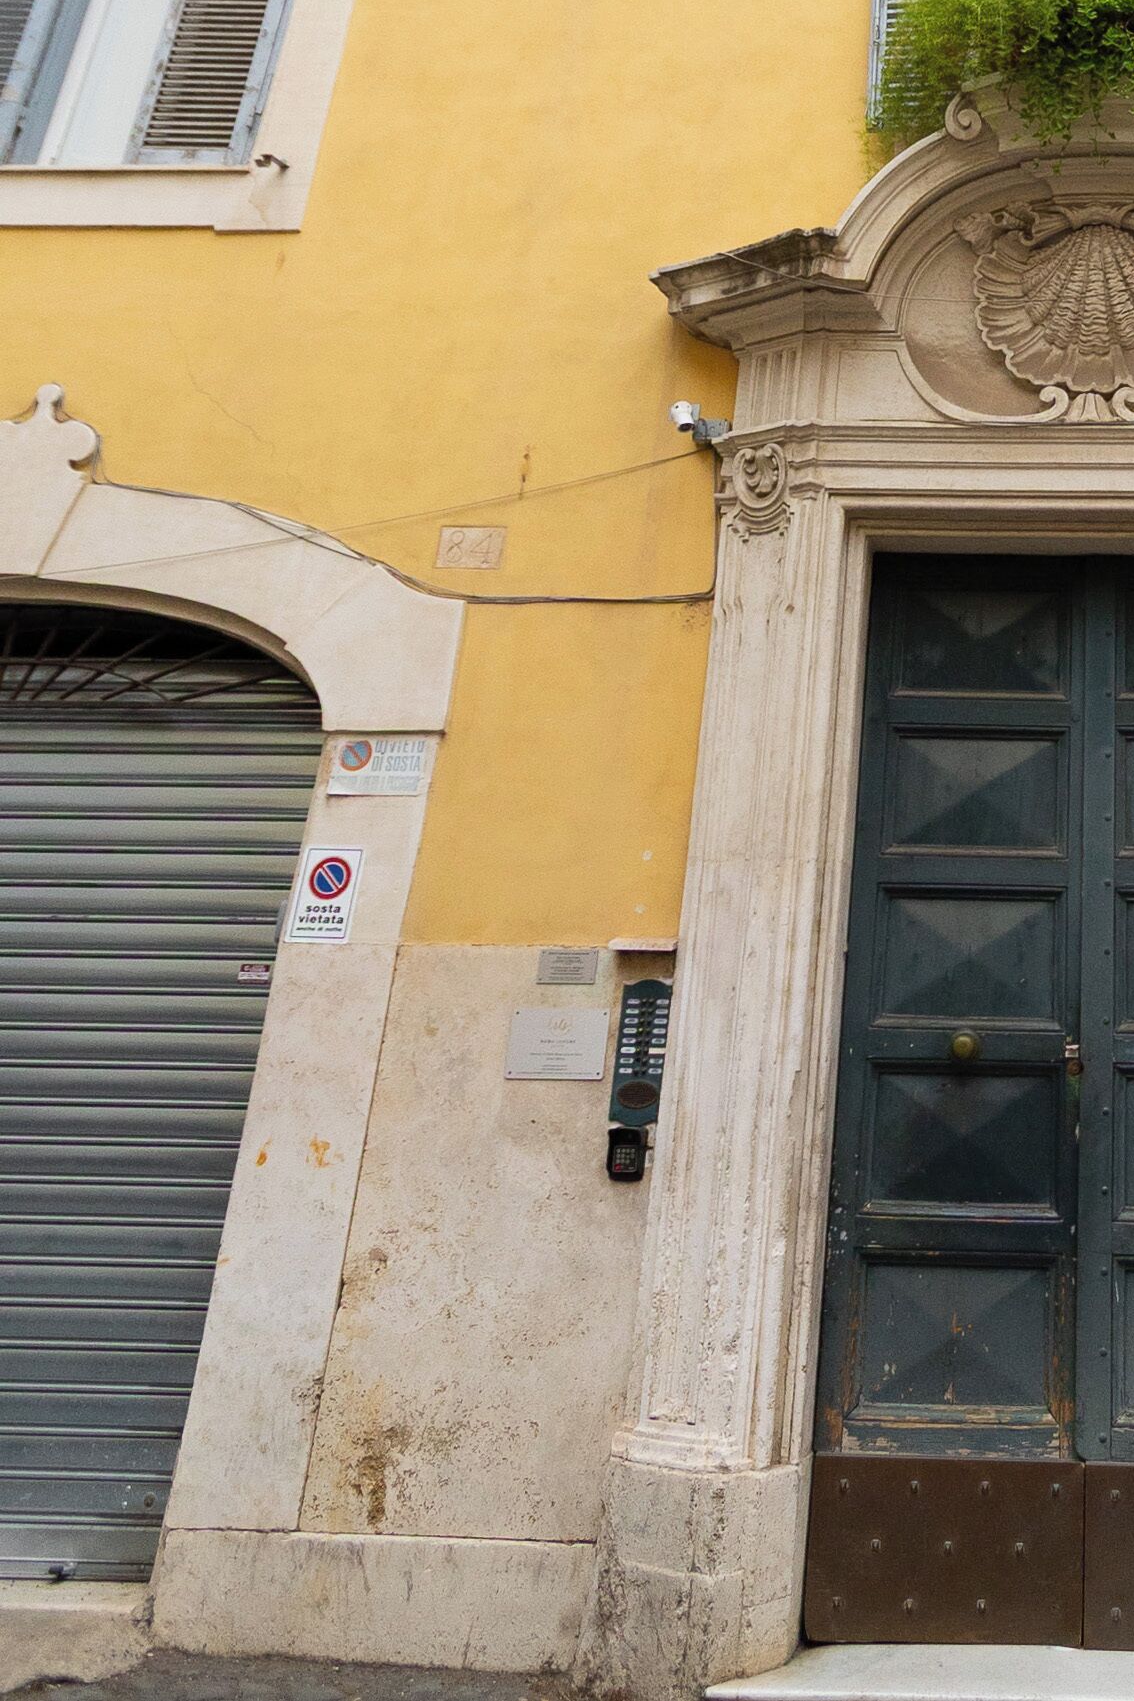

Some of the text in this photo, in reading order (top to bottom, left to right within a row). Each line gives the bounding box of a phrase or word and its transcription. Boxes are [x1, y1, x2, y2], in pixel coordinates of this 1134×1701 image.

[446, 530, 496, 565] 84
[370, 755, 421, 772] DI SOSTA
[305, 904, 341, 913] sosta
[298, 914, 344, 924] vietata
